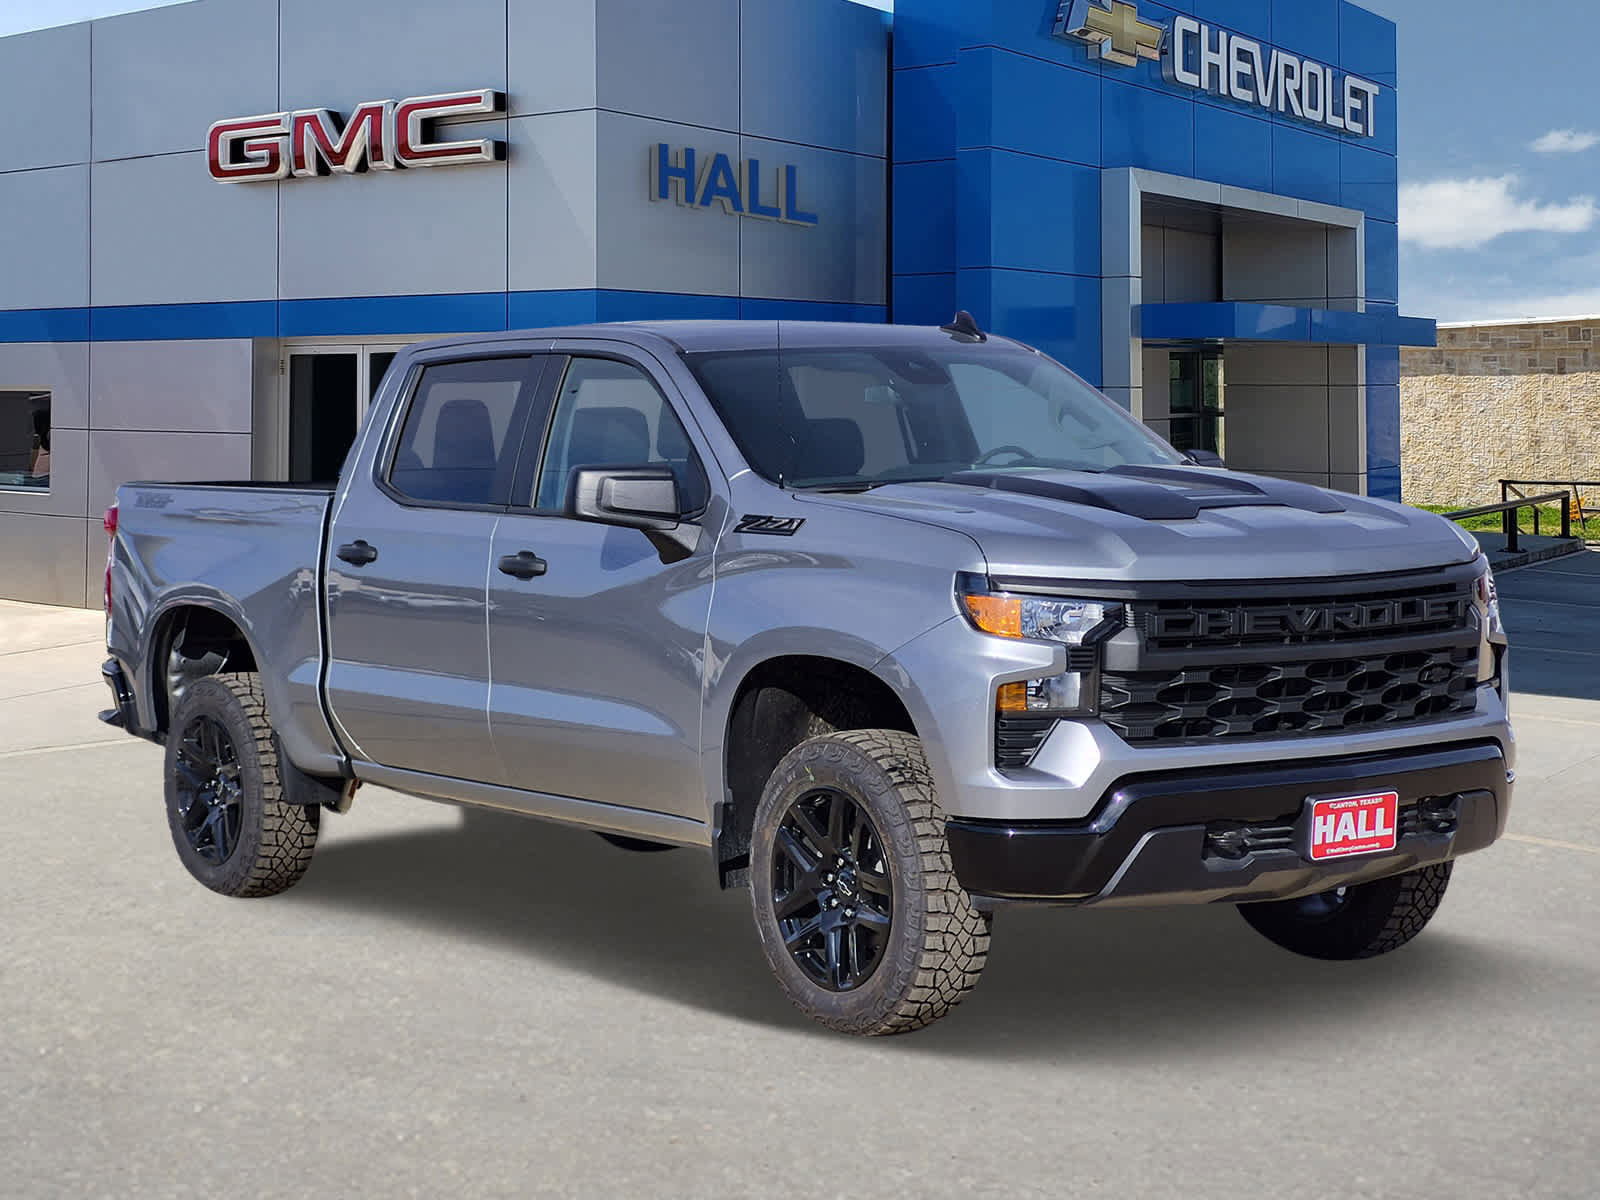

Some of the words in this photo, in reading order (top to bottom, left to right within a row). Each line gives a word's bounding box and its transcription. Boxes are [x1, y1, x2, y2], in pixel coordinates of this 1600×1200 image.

[1174, 15, 1379, 137] CHEVROLET
[207, 88, 506, 184] GMC
[651, 143, 819, 227] HALL
[1150, 597, 1470, 639] CHEVROLET
[1314, 807, 1392, 845] HALL
